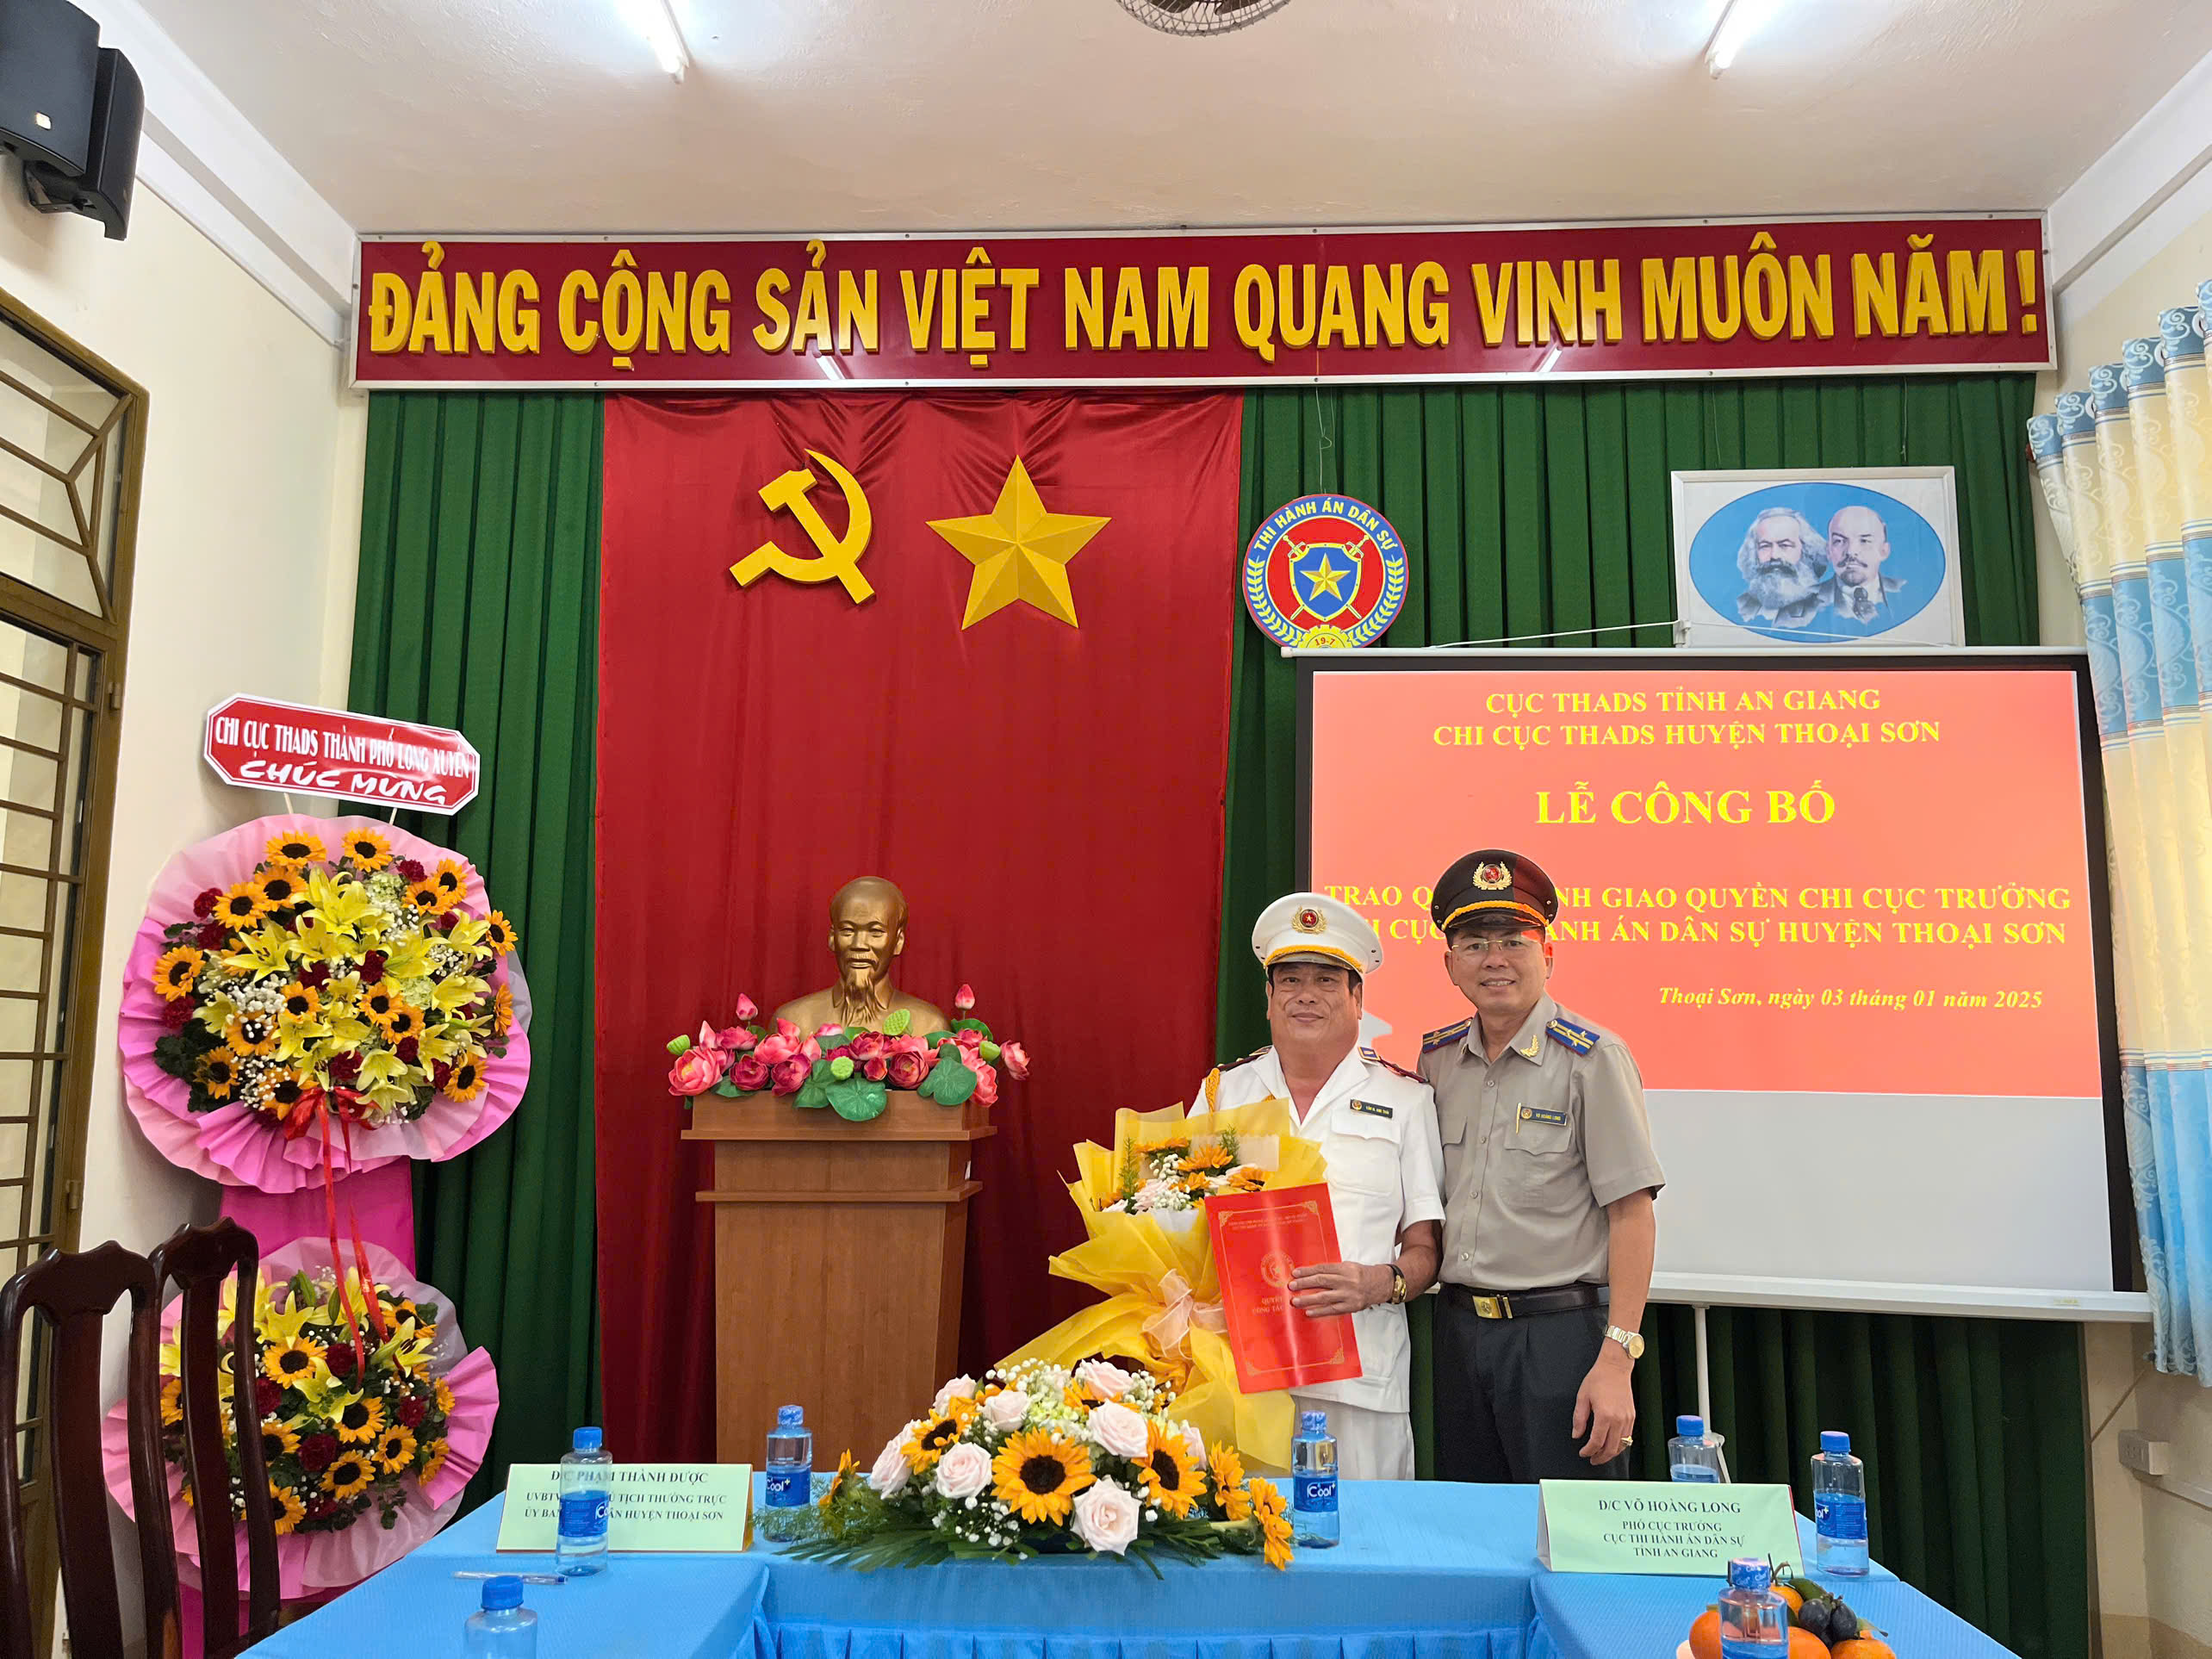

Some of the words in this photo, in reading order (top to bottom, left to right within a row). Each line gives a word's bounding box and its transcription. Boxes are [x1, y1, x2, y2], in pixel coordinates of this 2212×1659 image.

[369, 240, 542, 355] ĐẢNG
[558, 248, 731, 371] CỘNG
[752, 239, 881, 356] SẢN
[899, 245, 1040, 367] VIỆT
[1065, 265, 1209, 351] NAM
[1233, 262, 1451, 364] QUANG
[1470, 258, 1624, 346] VINH
[1641, 231, 1836, 343] MUÔN
[1254, 525, 1277, 551] THI
[1274, 500, 1317, 529] HÀNH
[1321, 497, 1345, 514] ÁN
[1347, 505, 1380, 531] DÂN
[1376, 530, 1399, 550] SỰ
[1314, 637, 1336, 646] 19-7
[1486, 693, 1544, 718] CỤC
[1552, 692, 1647, 713] THADS
[1656, 686, 1726, 712] TỈNH
[1735, 691, 1774, 711] AN
[1783, 689, 1880, 711] GIANG
[215, 717, 239, 746] CHI
[243, 720, 270, 758] CỤC
[274, 724, 318, 757] THADS
[322, 724, 366, 764] THÀNH
[369, 727, 395, 768] PHỐ
[397, 745, 429, 774] LONG
[432, 744, 470, 779] XUYÊN
[1433, 726, 1484, 746] CHI
[1493, 725, 1551, 751] CỤC
[1560, 724, 1655, 745] THADS
[1665, 721, 1765, 749] HUYỆN
[1774, 723, 1869, 749] THOẠI
[1880, 720, 1940, 743] SƠN
[239, 760, 341, 788] CHÚC
[1535, 780, 1596, 824] LỄ
[1611, 780, 1752, 824] CÔNG
[1766, 780, 1835, 824] BỐ
[1325, 885, 1402, 906] TRAO
[1554, 887, 1593, 908] NH
[1601, 887, 1677, 908] GIAO
[1686, 881, 1788, 912] QUYỀN
[1799, 888, 1854, 909] CHI
[1862, 888, 1926, 914] CỤC
[1935, 882, 2071, 910] TRƯỞNG
[1611, 916, 1651, 941] ÁN
[1660, 916, 1719, 941] DÂN
[1730, 918, 1770, 947] SỰ
[1779, 919, 1882, 948] HUYỆN
[1892, 923, 1992, 949] THOẠI
[2004, 922, 2066, 944] SƠN
[1660, 987, 1713, 1009] Thoại
[1718, 988, 1762, 1007] Sơn,
[1768, 988, 1815, 1010] ngày
[1821, 989, 1843, 1006] 03
[1849, 989, 1907, 1010] tháng
[1913, 990, 1936, 1007] 01
[1943, 991, 1987, 1008] năm
[1994, 991, 2043, 1009] 2025
[619, 1469, 666, 1482] THÀNH
[619, 1494, 644, 1504] TỊCH
[1624, 1498, 1644, 1512] VÕ
[1648, 1498, 1698, 1513] HOÀNG
[1701, 1501, 1741, 1513] LONG
[625, 1509, 662, 1521] HUYỆN
[667, 1510, 699, 1522] THOẠI
[1648, 1521, 1672, 1533] CỤC
[1603, 1533, 1626, 1544] CỤC
[1629, 1534, 1649, 1544] THI
[1663, 1549, 1679, 1557] AN
[1681, 1549, 1718, 1558] GIANG
